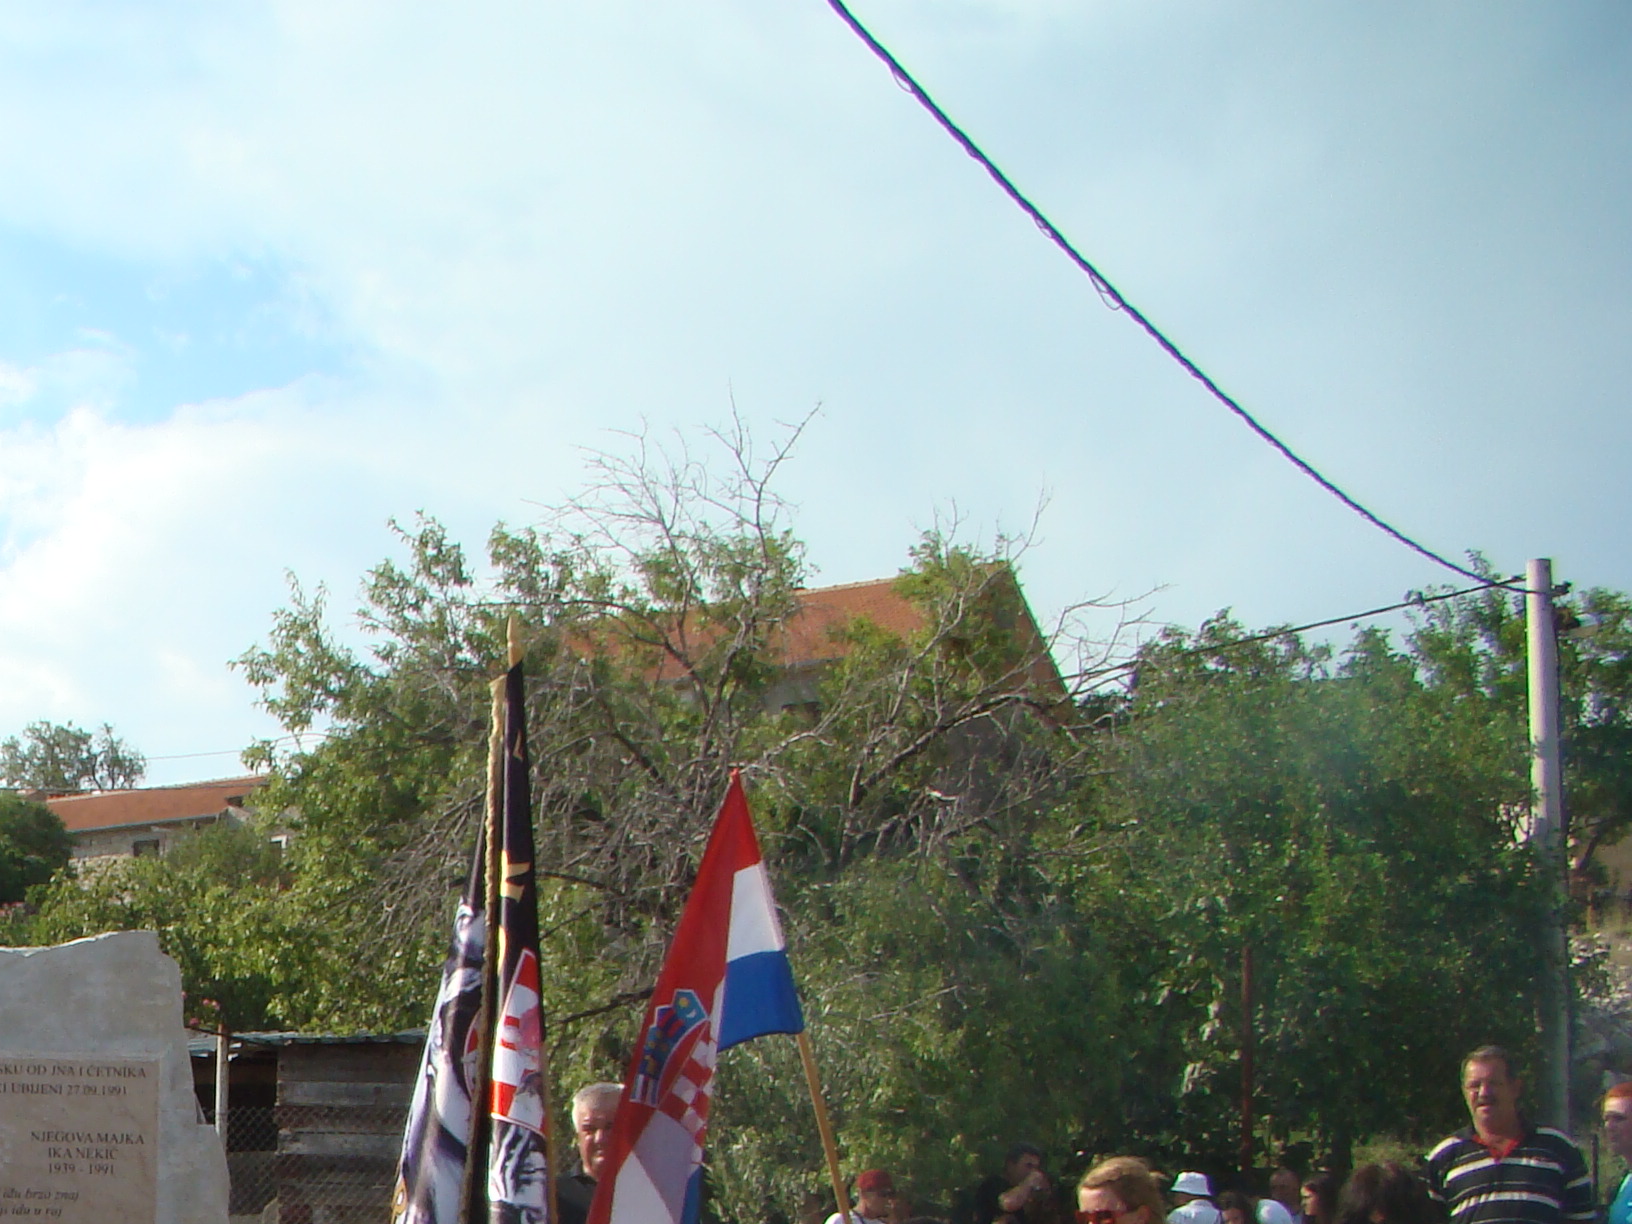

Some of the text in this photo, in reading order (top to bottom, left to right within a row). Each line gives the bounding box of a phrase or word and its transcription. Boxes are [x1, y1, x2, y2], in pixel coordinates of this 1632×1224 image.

[26, 1064, 47, 1076] OD
[51, 1065, 76, 1077] JNA
[10, 1082, 63, 1095] UBIJENI
[30, 1130, 146, 1145] NJEGOVA MAJKA
[47, 1147, 73, 1159] IKA
[48, 1162, 76, 1175] 1939
[88, 1163, 115, 1175] 1991
